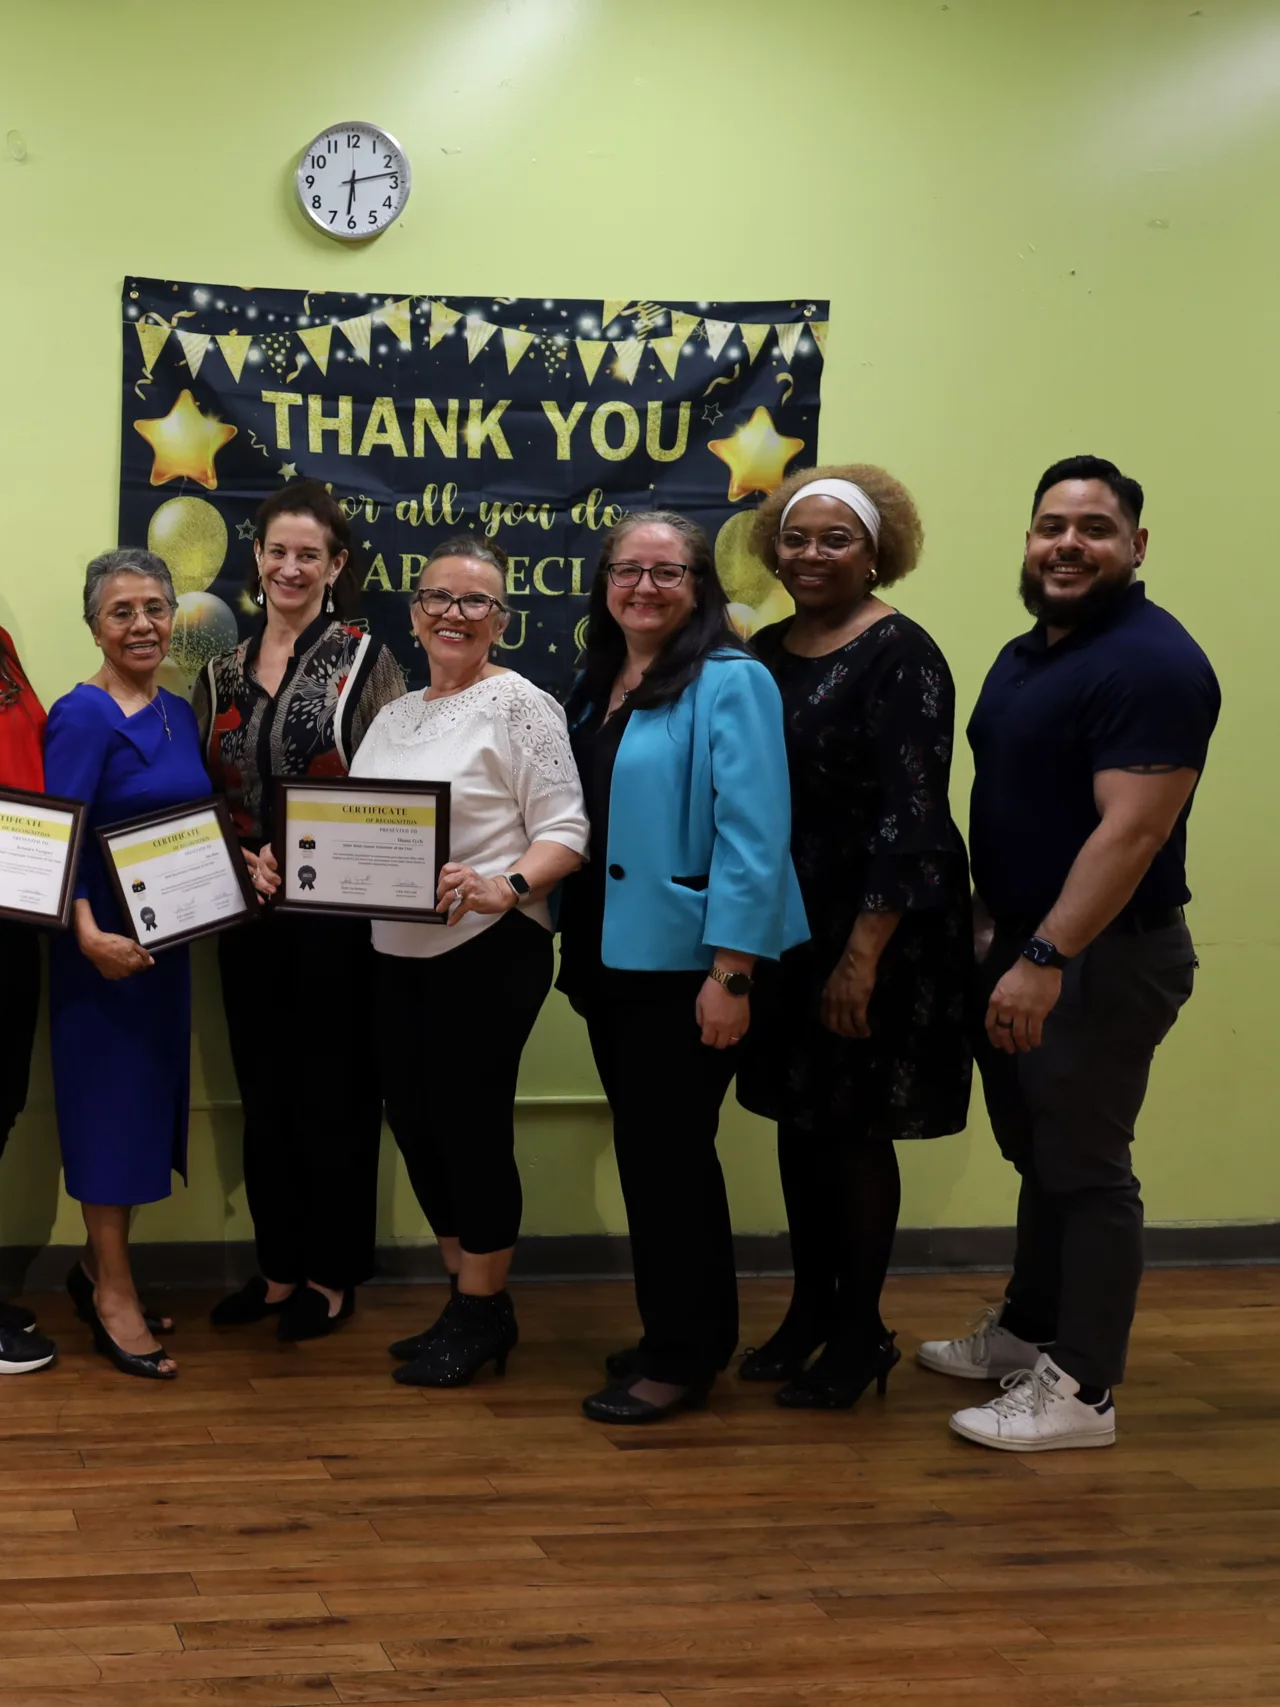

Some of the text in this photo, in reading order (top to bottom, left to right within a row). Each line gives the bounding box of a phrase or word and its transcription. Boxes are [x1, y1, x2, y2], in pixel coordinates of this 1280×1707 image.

[327, 140, 338, 154] 11
[347, 134, 360, 148] 12
[372, 140, 376, 154] 1
[311, 154, 326, 169] 10
[383, 154, 393, 169] 2
[305, 175, 315, 189] 9
[389, 175, 399, 189] 3
[312, 195, 322, 209] 8
[382, 195, 392, 209] 4
[328, 210, 338, 224] 7
[347, 215, 357, 229] 6
[368, 210, 378, 224] 5
[261, 390, 692, 462] THANK YOU
[325, 482, 628, 538] or all you do
[342, 805, 408, 816] CERTIFICATE
[152, 828, 200, 848] CERTIFICATE
